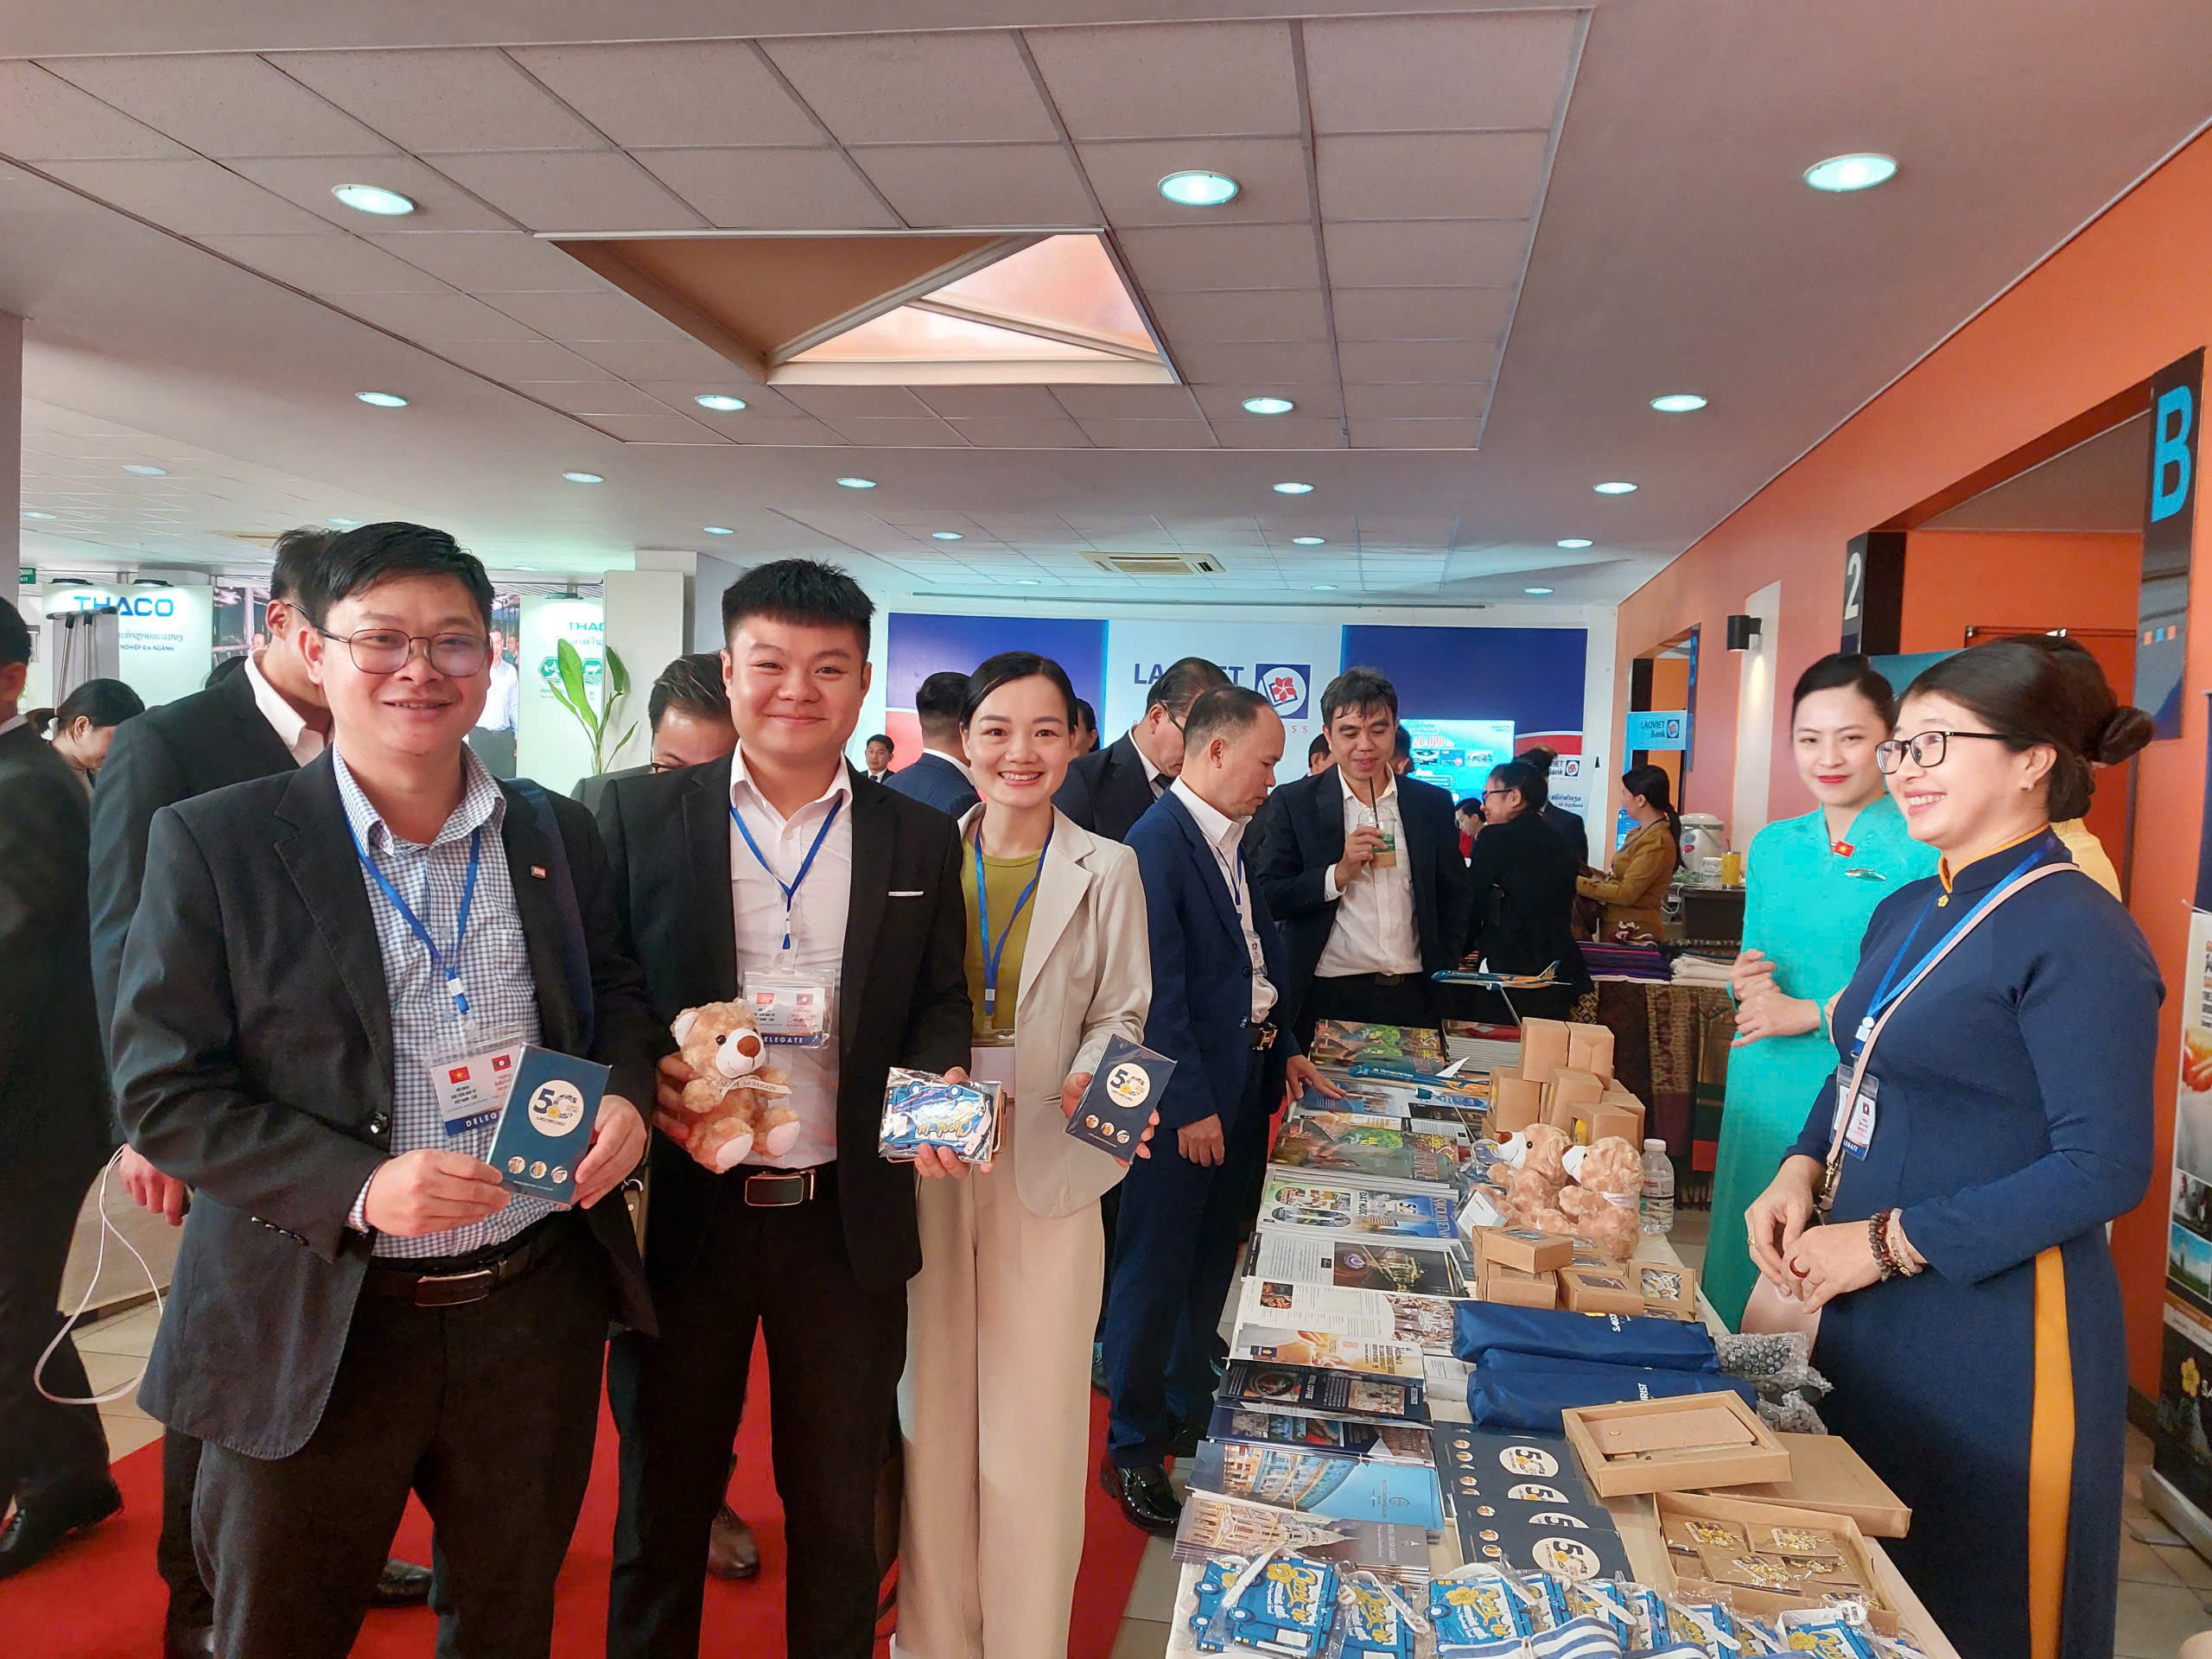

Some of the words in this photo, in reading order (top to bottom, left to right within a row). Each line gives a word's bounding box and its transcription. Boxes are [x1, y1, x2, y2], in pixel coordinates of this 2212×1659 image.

[2151, 385, 2192, 523] B
[73, 595, 174, 617] THACO
[1845, 551, 1862, 620] 2
[465, 1112, 501, 1128] DELEG
[1287, 1567, 1318, 1623] Check-in
